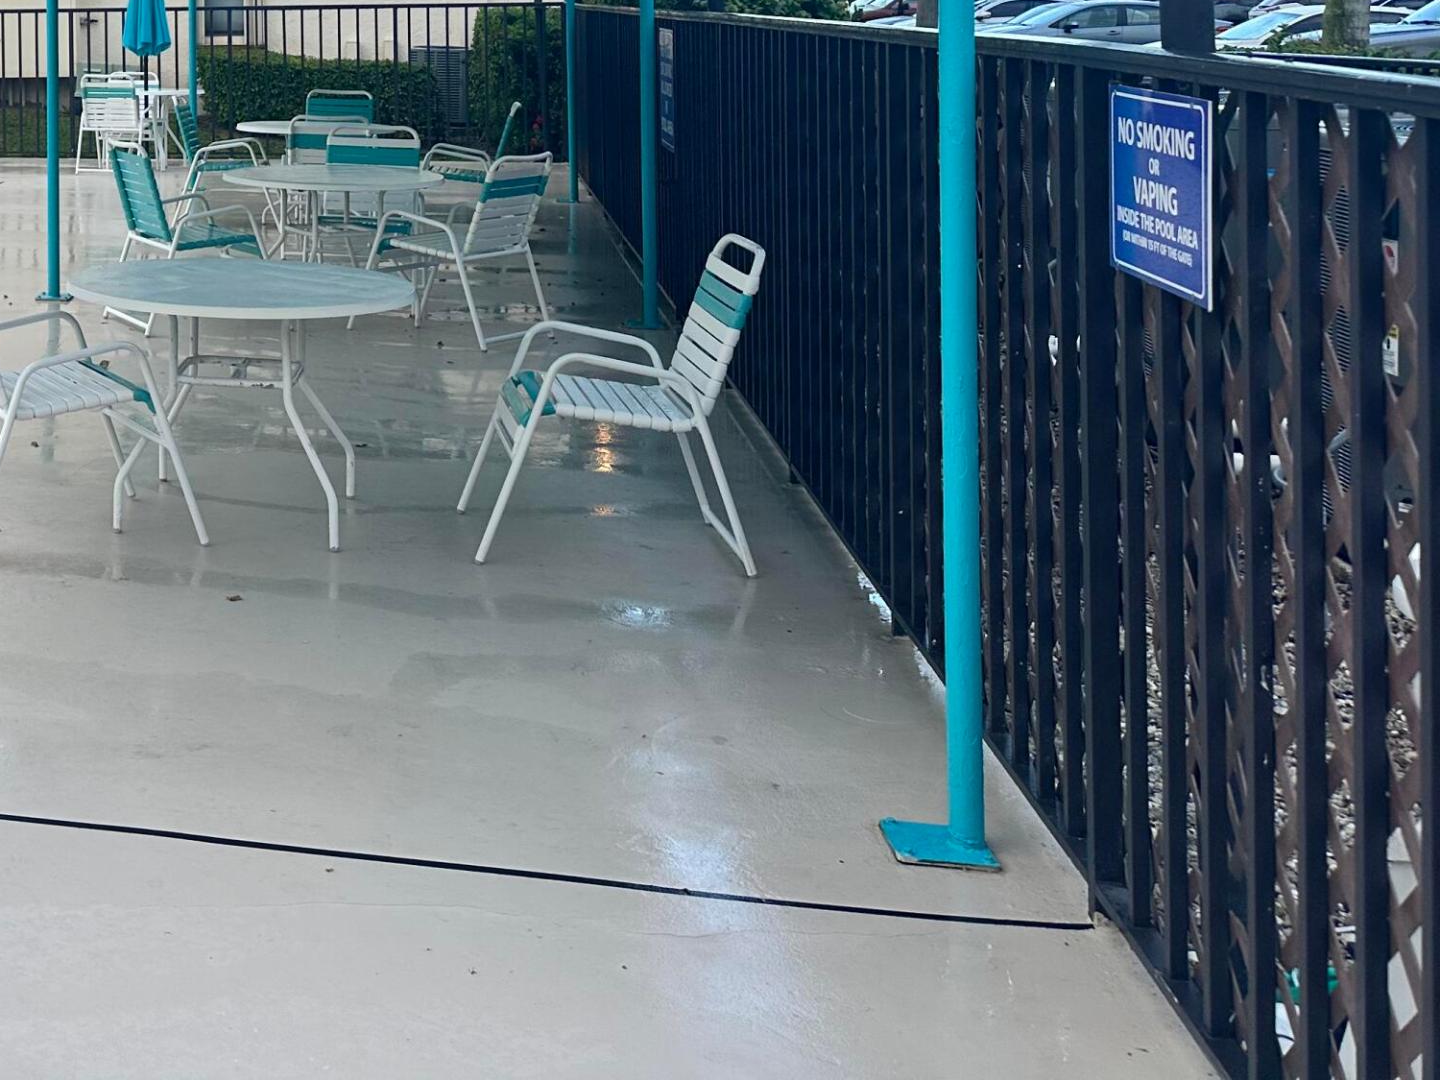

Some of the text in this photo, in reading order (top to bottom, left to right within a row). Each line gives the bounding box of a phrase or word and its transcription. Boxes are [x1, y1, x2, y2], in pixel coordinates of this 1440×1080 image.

[1118, 116, 1195, 161] NO SMOKING
[1148, 157, 1160, 177] OR
[1133, 176, 1178, 216] VAPING
[1117, 205, 1199, 250] INSIDE THE POOL AREA
